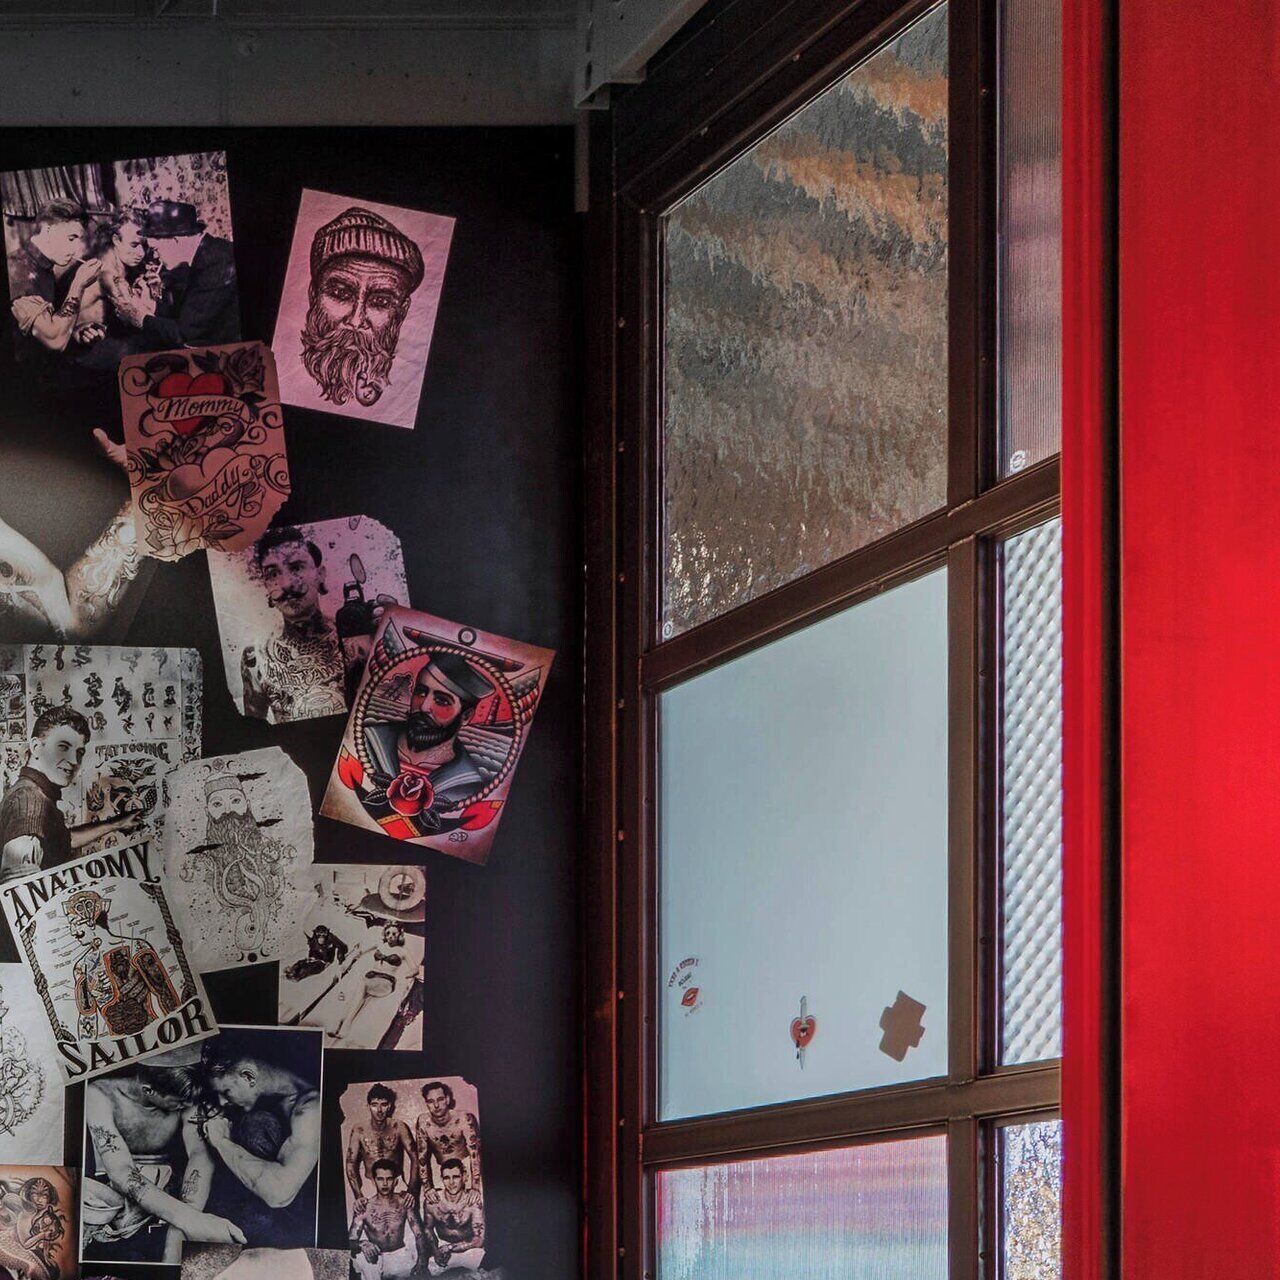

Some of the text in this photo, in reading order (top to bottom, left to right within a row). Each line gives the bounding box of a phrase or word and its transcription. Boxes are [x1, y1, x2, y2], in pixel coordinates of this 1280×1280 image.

[158, 399, 244, 420] Mommy
[182, 466, 242, 516] Daddy
[95, 742, 171, 764] TATTOOING
[57, 997, 213, 1079] SAILOR
